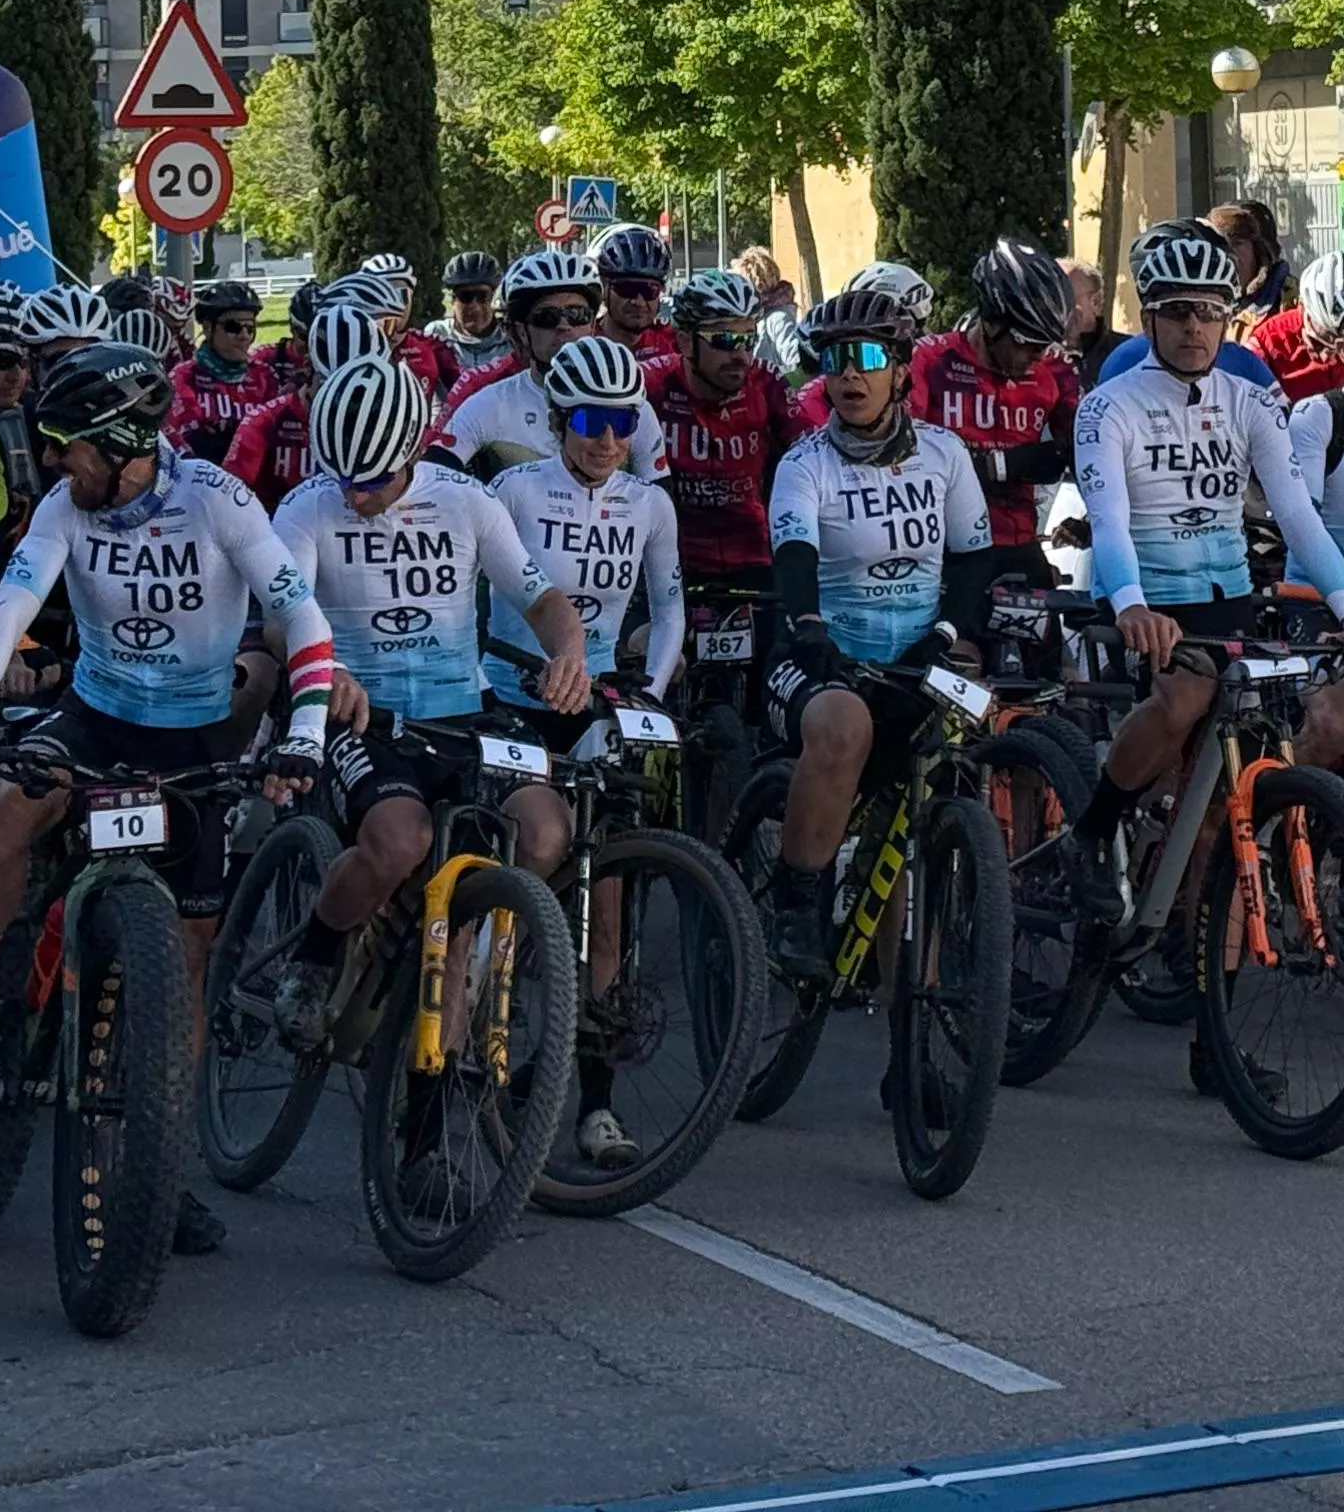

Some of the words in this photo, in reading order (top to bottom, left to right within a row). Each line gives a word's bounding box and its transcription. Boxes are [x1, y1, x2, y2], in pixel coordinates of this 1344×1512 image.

[156, 162, 214, 199] 20
[104, 360, 148, 383] KASK
[942, 391, 1046, 432] HU108
[1143, 439, 1233, 472] TEAM
[838, 479, 937, 521] TEAM
[1181, 472, 1239, 500] 108
[334, 531, 454, 564] TEAM
[537, 518, 635, 556] TEAM
[880, 514, 941, 551] 108
[1170, 523, 1226, 542] TOYOTA
[85, 535, 200, 578] TEAM
[382, 564, 457, 599] 108
[575, 558, 633, 590] 108
[123, 582, 205, 614] 108
[863, 583, 921, 598] TOYOTA
[110, 648, 182, 665] TOYOTA
[370, 634, 440, 654] TOYOTA
[952, 678, 968, 696] 3
[640, 714, 654, 733] 4
[506, 744, 522, 761] 6
[112, 814, 145, 839] 10
[1196, 903, 1210, 993] MAXXIS
